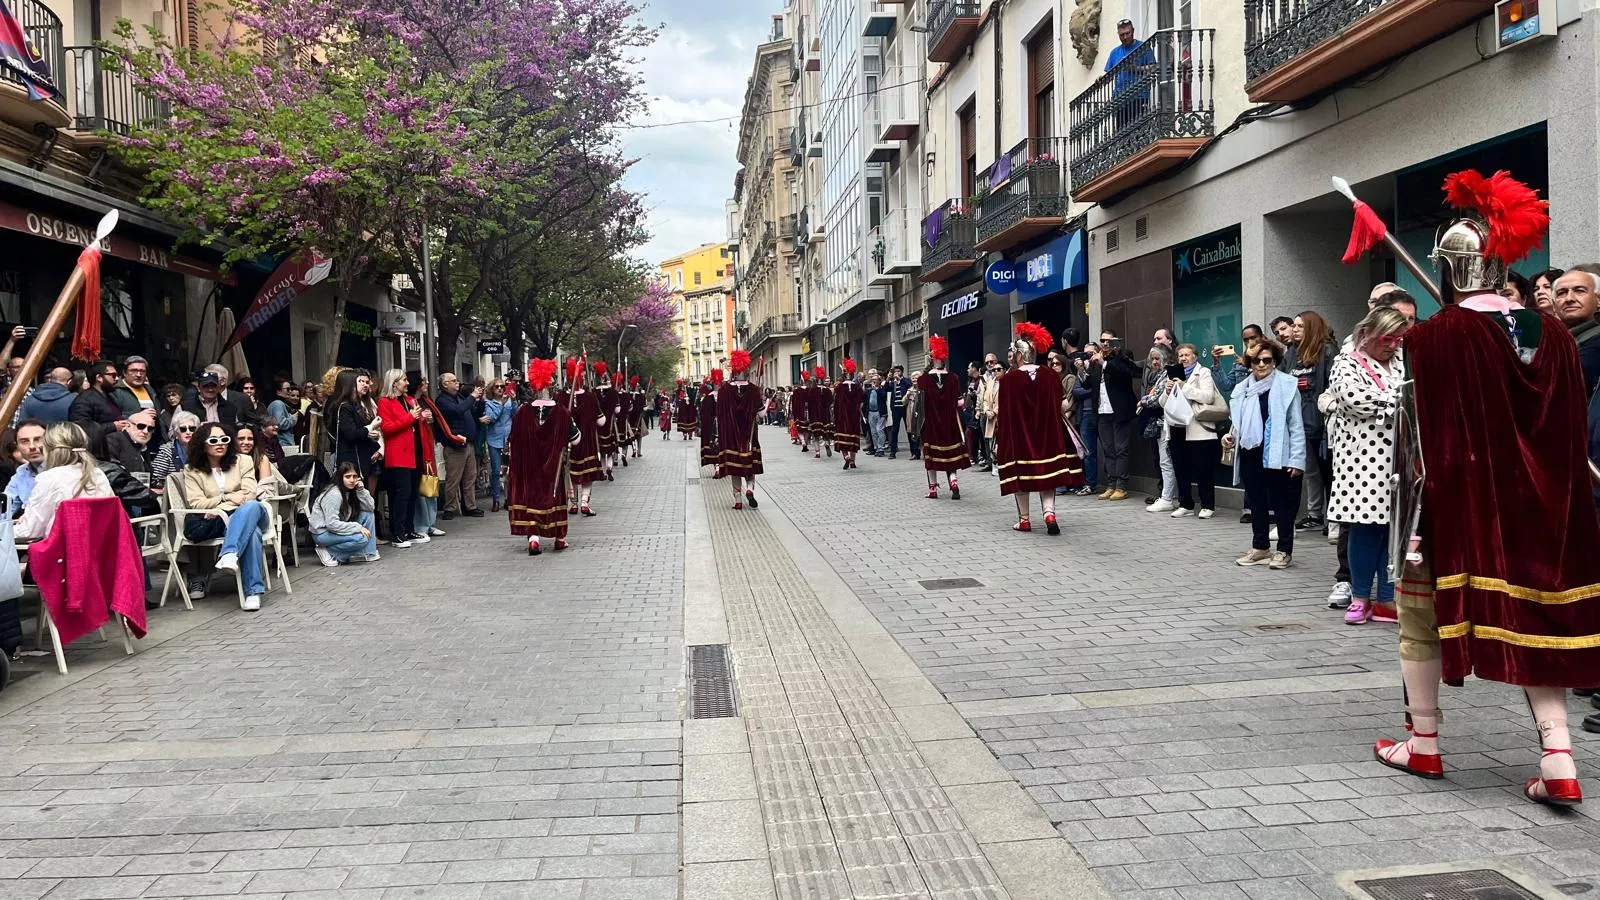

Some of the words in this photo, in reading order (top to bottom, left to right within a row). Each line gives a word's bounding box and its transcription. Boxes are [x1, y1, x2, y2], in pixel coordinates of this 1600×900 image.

[139, 244, 169, 268] BAR
[1193, 236, 1242, 267] CaixaBank
[992, 270, 1015, 280] DIGI
[1027, 253, 1052, 283] DIGI
[258, 273, 297, 304] oscense
[243, 286, 297, 332] TARDEO
[940, 290, 979, 320] DECIMAS
